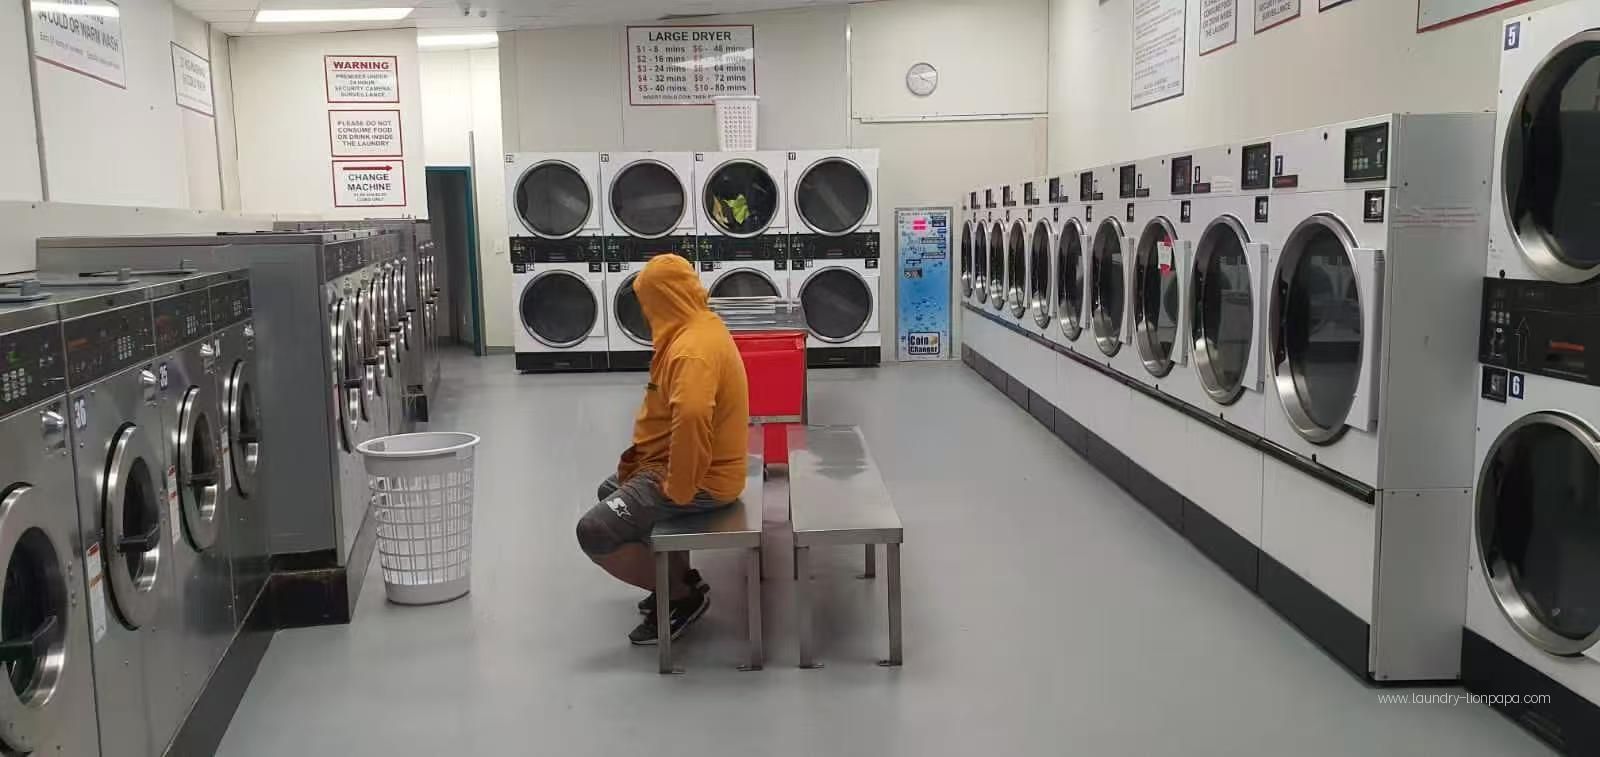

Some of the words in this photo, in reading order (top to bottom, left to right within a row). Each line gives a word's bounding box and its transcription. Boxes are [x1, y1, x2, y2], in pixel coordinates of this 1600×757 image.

[69, 16, 79, 33] OR
[648, 31, 689, 41] LARGE
[692, 31, 732, 41] DRYER
[1508, 27, 1516, 46] 5
[655, 55, 663, 63] 16
[333, 61, 390, 70] WARNING
[654, 64, 664, 72] 24
[666, 65, 686, 73] mins
[726, 64, 746, 72] mins
[638, 74, 647, 82] $4
[655, 74, 664, 82] 32
[666, 74, 686, 82] mins
[714, 74, 724, 82] 72
[726, 74, 746, 82] mins
[655, 84, 665, 92] 40
[666, 84, 687, 92] mins
[695, 84, 709, 92] $10
[726, 84, 747, 92] mins
[348, 173, 390, 181] CHANGE
[346, 183, 392, 192] MACHINE
[910, 335, 929, 346] Coin
[1513, 375, 1520, 395] 6
